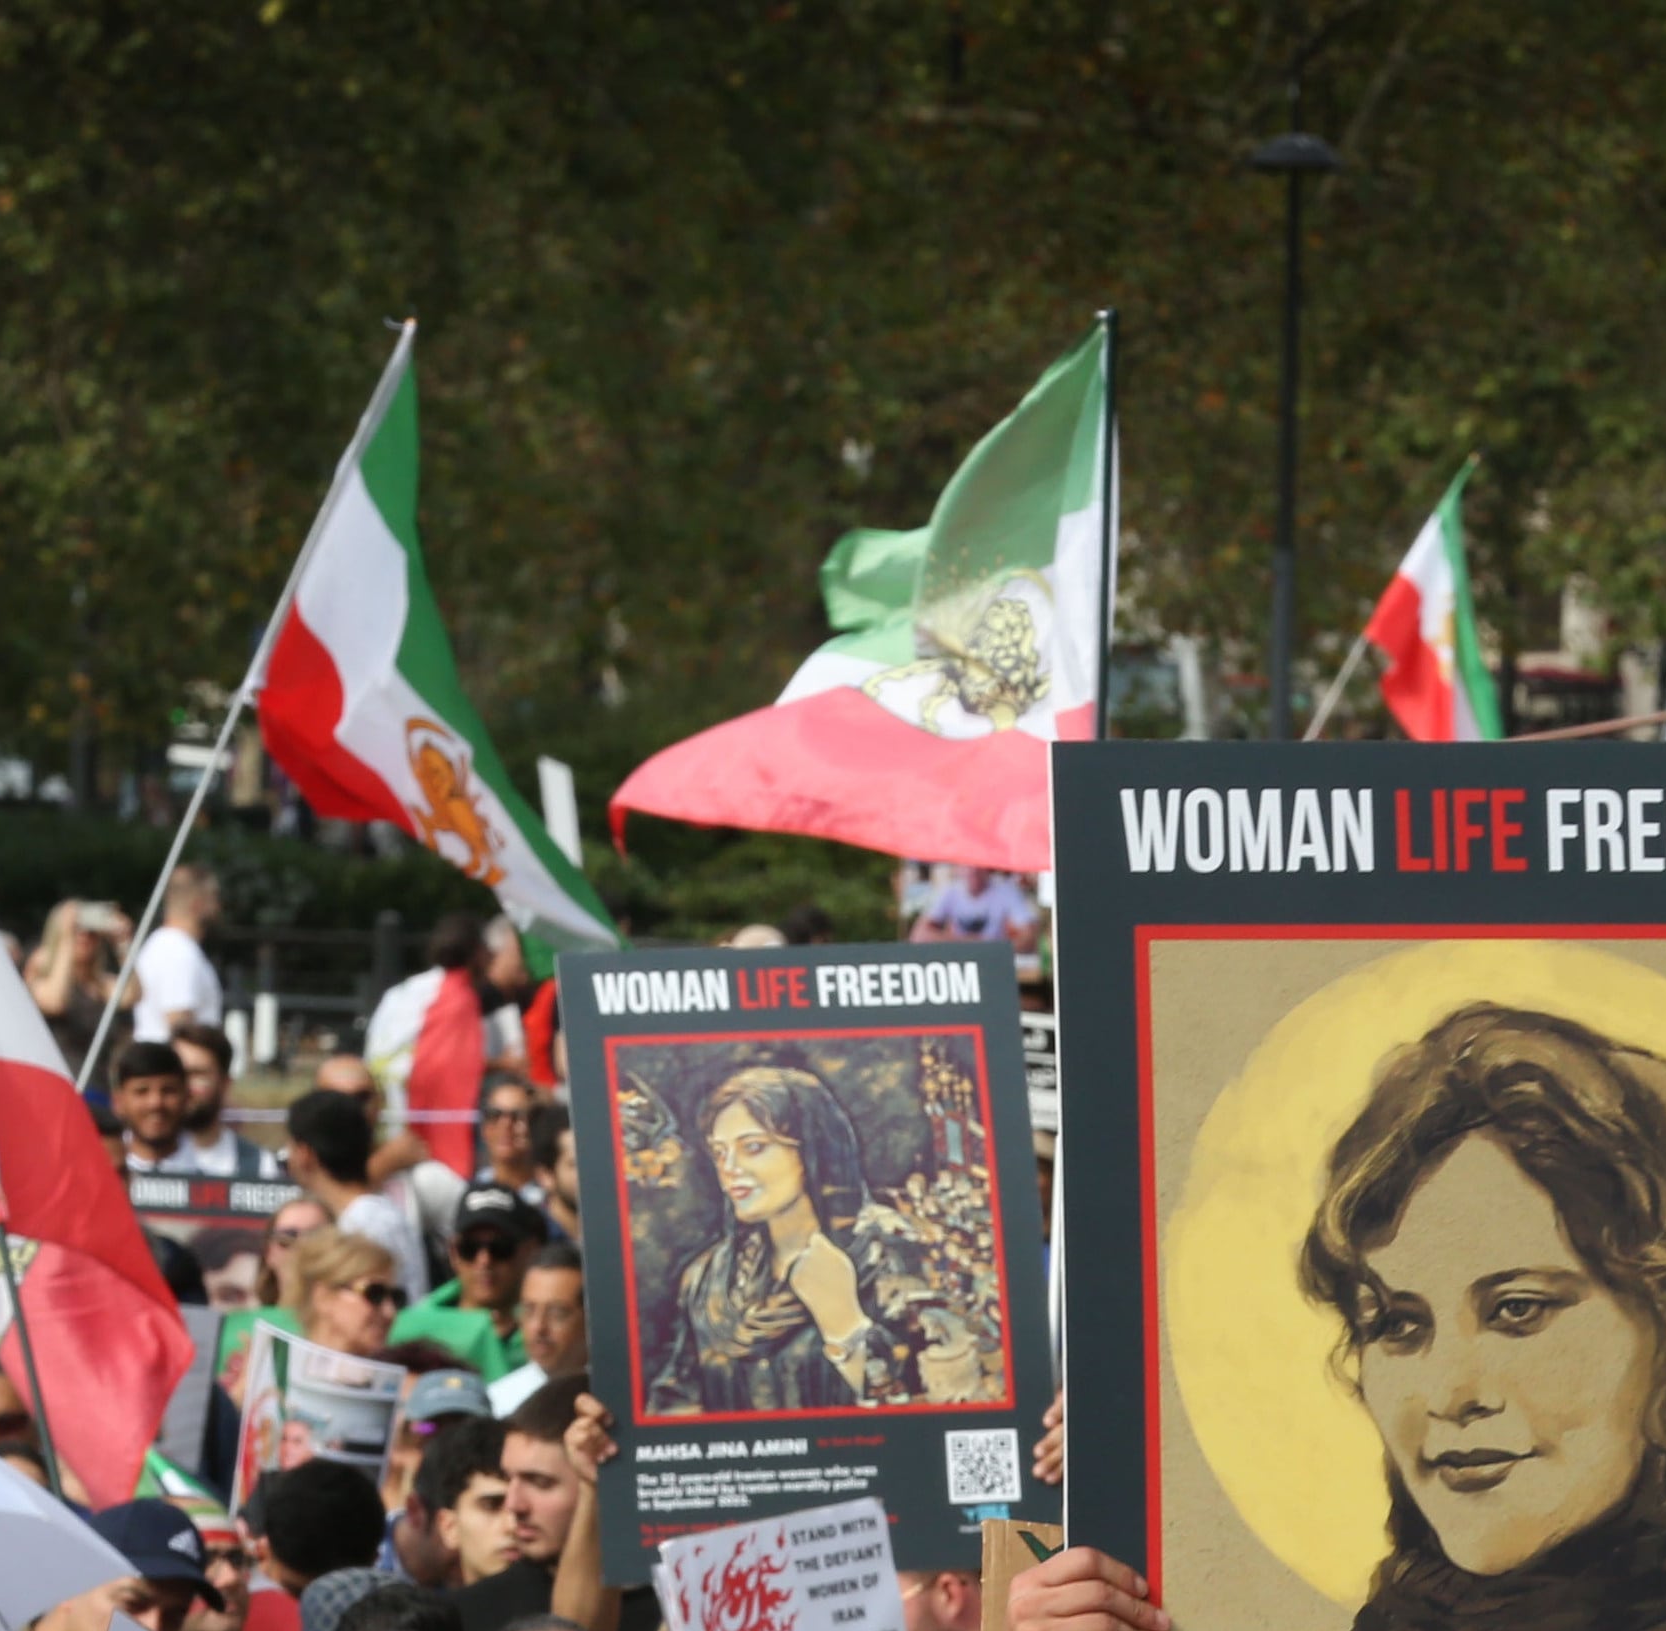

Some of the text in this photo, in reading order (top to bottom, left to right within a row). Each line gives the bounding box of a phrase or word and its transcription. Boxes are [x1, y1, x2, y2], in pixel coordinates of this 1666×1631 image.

[1120, 788, 1374, 873] WOMAN
[1394, 789, 1528, 873] LIFE
[592, 962, 982, 1015] WOMAN LIFE FREEDOM
[636, 1443, 703, 1462] MAHSA
[706, 1441, 749, 1459] JINA
[752, 1438, 809, 1456] AMINI
[790, 1525, 837, 1547] STAND
[841, 1517, 877, 1536] WITH
[795, 1543, 883, 1574] THE DEFIANT
[807, 1572, 879, 1600] WOMEN OF
[832, 1605, 867, 1624] IRAN
